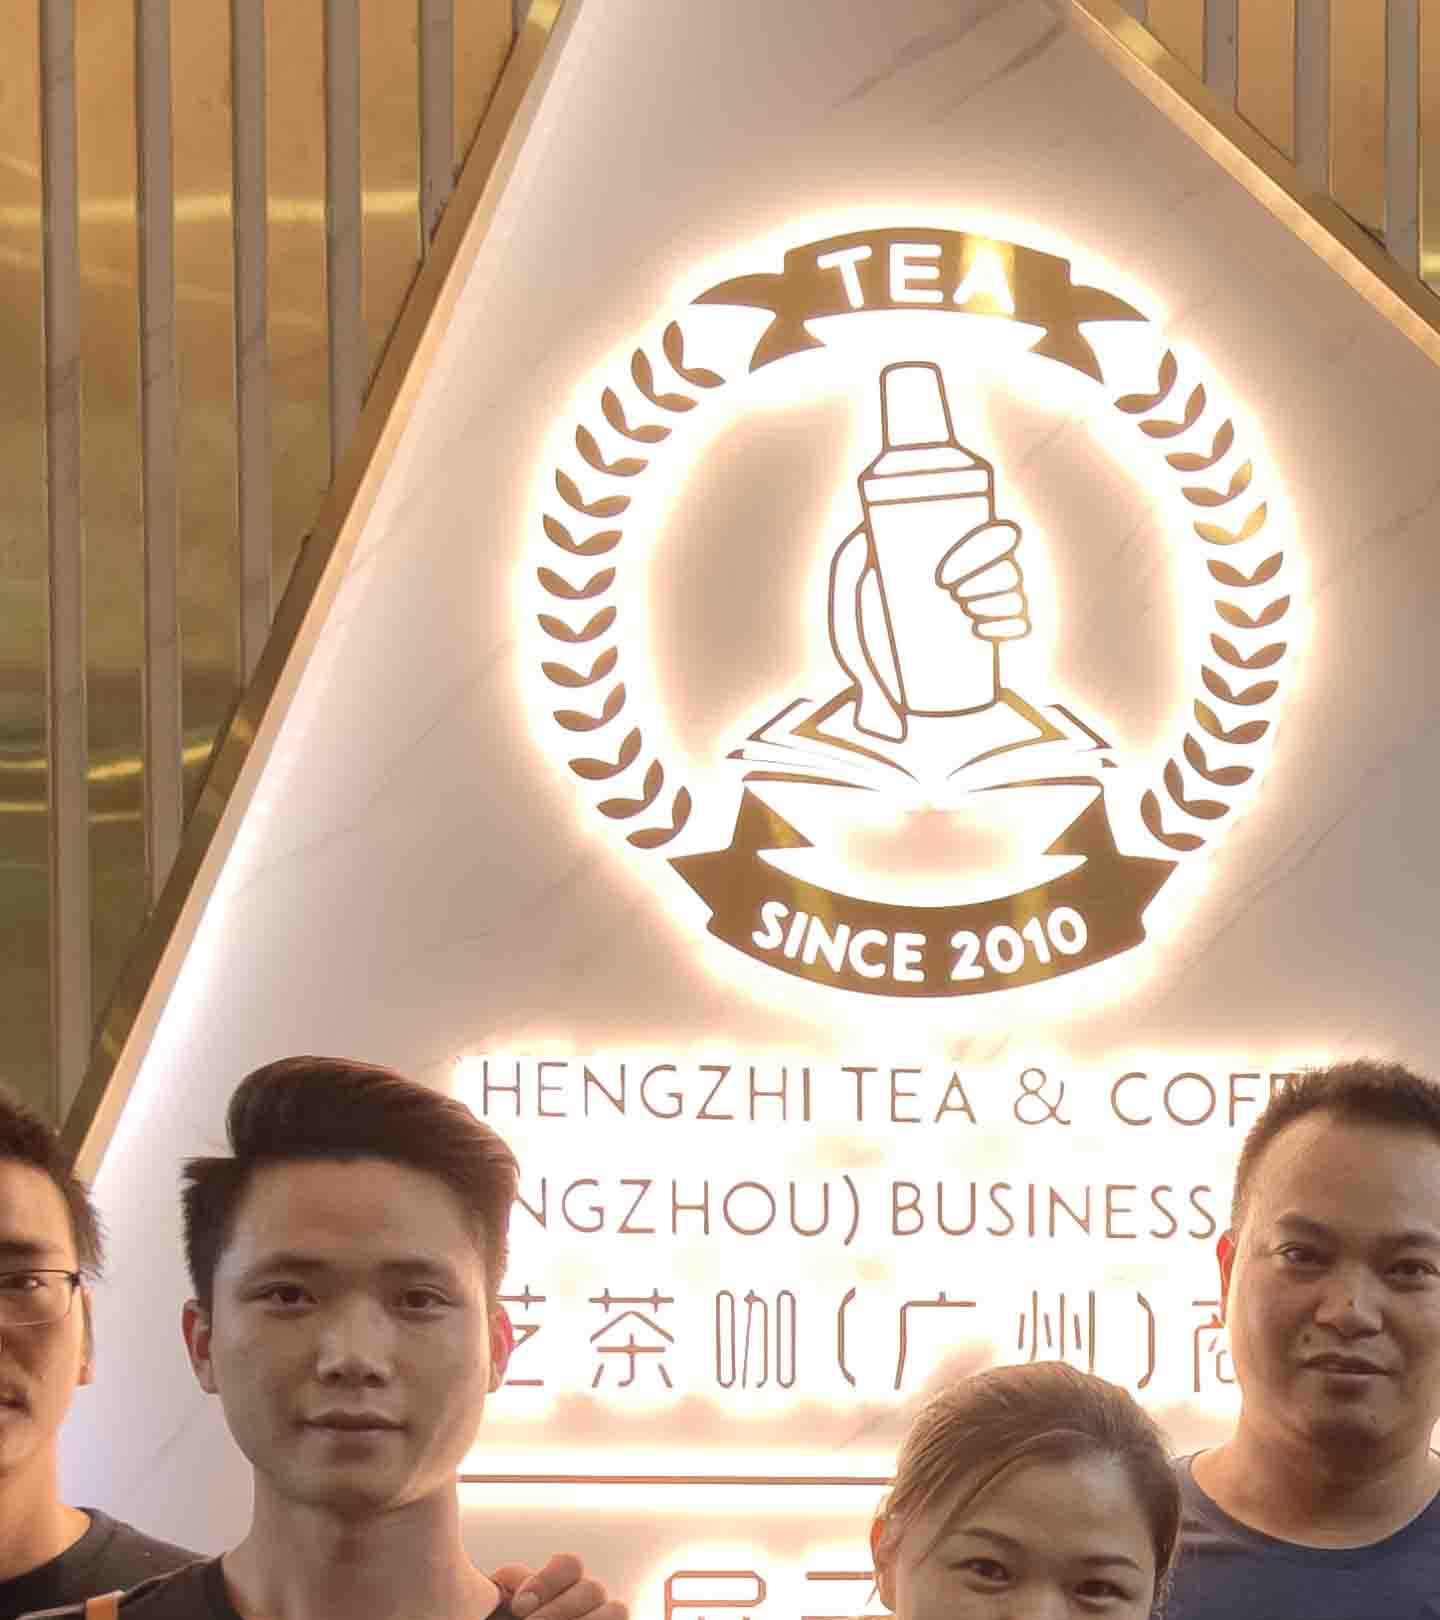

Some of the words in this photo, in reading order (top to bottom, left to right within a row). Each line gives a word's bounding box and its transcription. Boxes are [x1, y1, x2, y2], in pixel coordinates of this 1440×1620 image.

[815, 241, 1017, 315] TEA
[751, 899, 928, 983] SINCE
[948, 904, 1091, 983] 2010
[481, 1059, 812, 1122] HENGZHI
[840, 1066, 978, 1125] TEA
[1013, 1067, 1071, 1126] &
[514, 1174, 861, 1247] NGZHOU)
[891, 1180, 1218, 1241] BUSINESS
